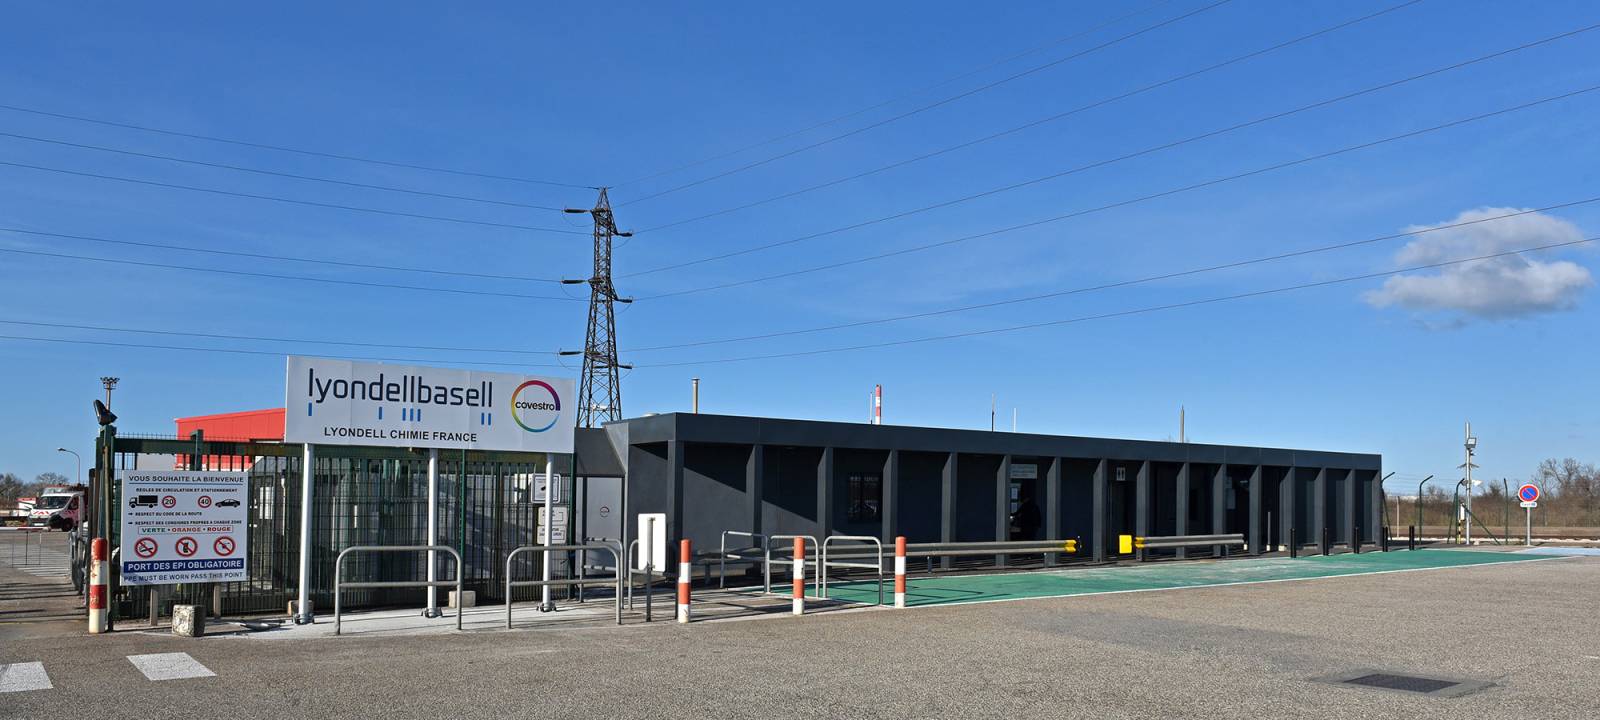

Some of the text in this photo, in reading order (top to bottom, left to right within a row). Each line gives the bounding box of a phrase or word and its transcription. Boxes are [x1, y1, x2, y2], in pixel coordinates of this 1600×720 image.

[308, 368, 493, 408] lyondellbasell
[515, 401, 555, 411] covestro
[324, 427, 477, 442] LYONDELL CHIMIE FRANCE
[128, 560, 241, 571] PORT DES EPI OBLIGATOIRE
